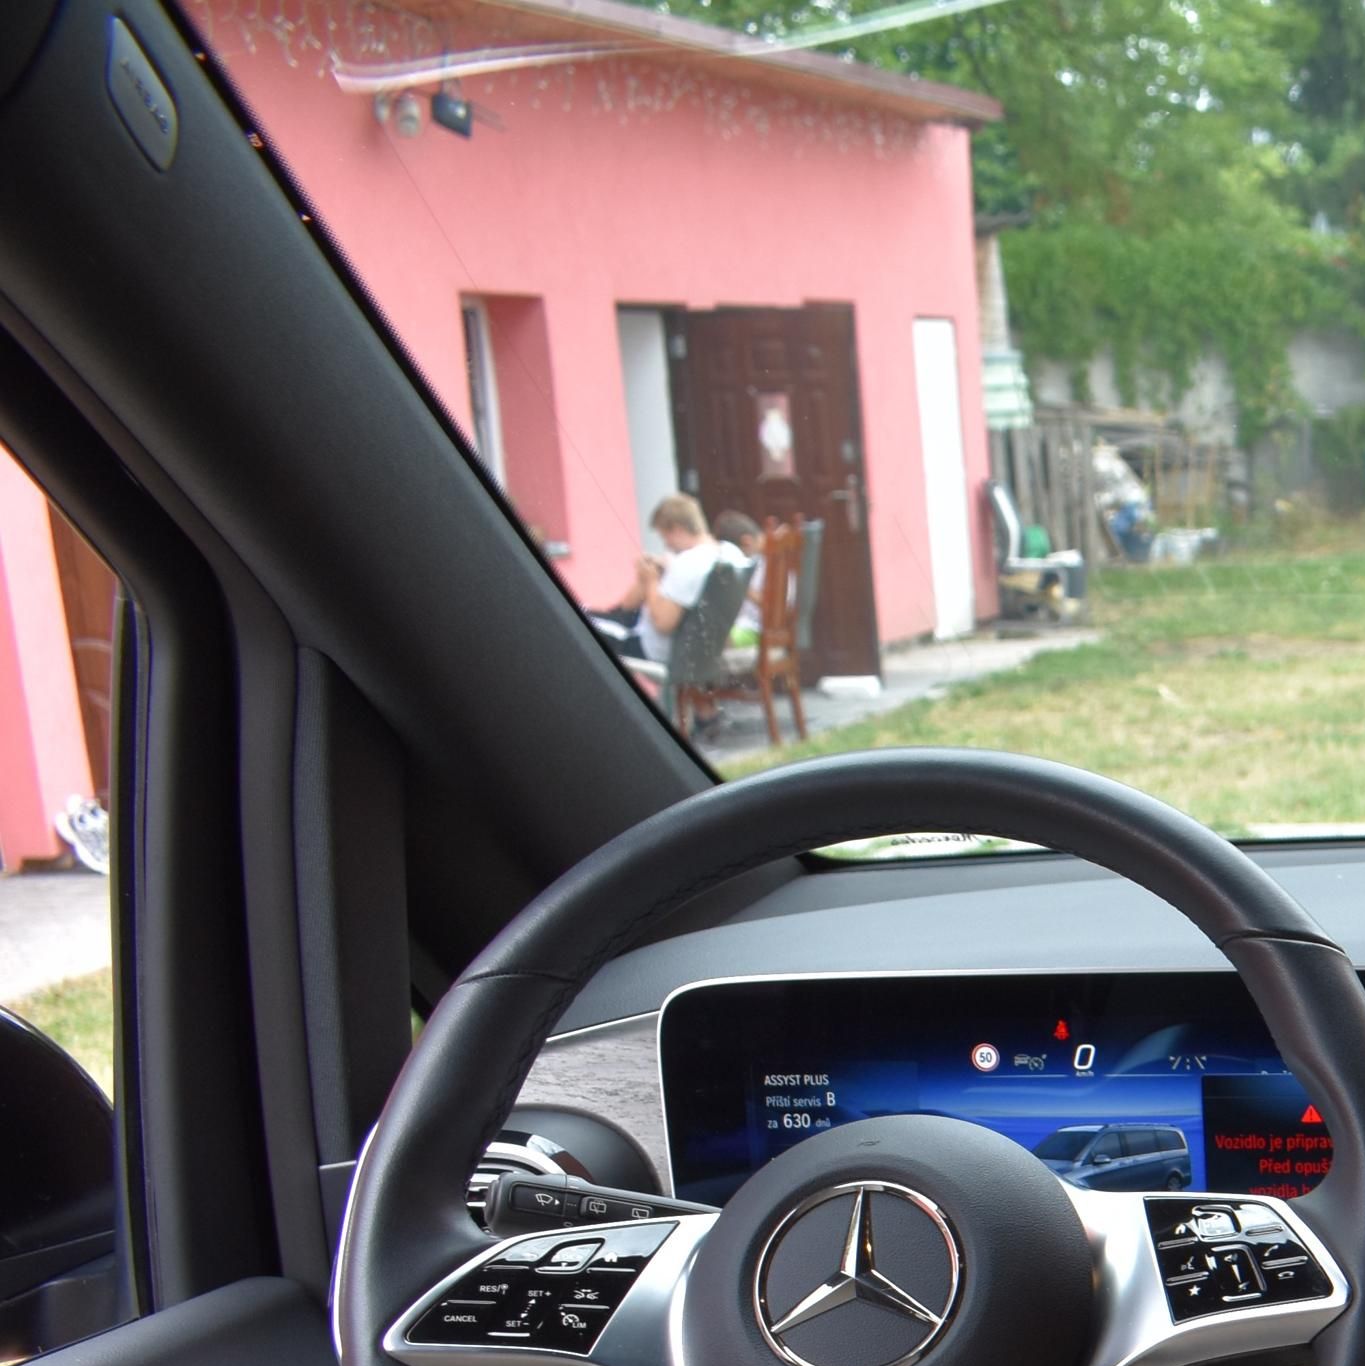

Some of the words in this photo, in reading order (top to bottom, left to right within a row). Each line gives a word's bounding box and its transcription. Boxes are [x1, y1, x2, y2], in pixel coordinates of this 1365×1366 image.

[979, 1052, 993, 1063] 50
[1073, 1044, 1096, 1070] 0
[764, 1074, 801, 1086] ASSYST
[803, 1074, 829, 1086] PLUS
[792, 1096, 822, 1107] servis
[826, 1091, 836, 1106] B
[767, 1120, 779, 1129] za
[783, 1113, 811, 1129] 630
[1215, 1134, 1266, 1150] Vozidlo
[1270, 1134, 1283, 1152] je
[1259, 1158, 1291, 1174] Před
[1295, 1157, 1332, 1175] opuš
[443, 1315, 477, 1323] CANCEL
